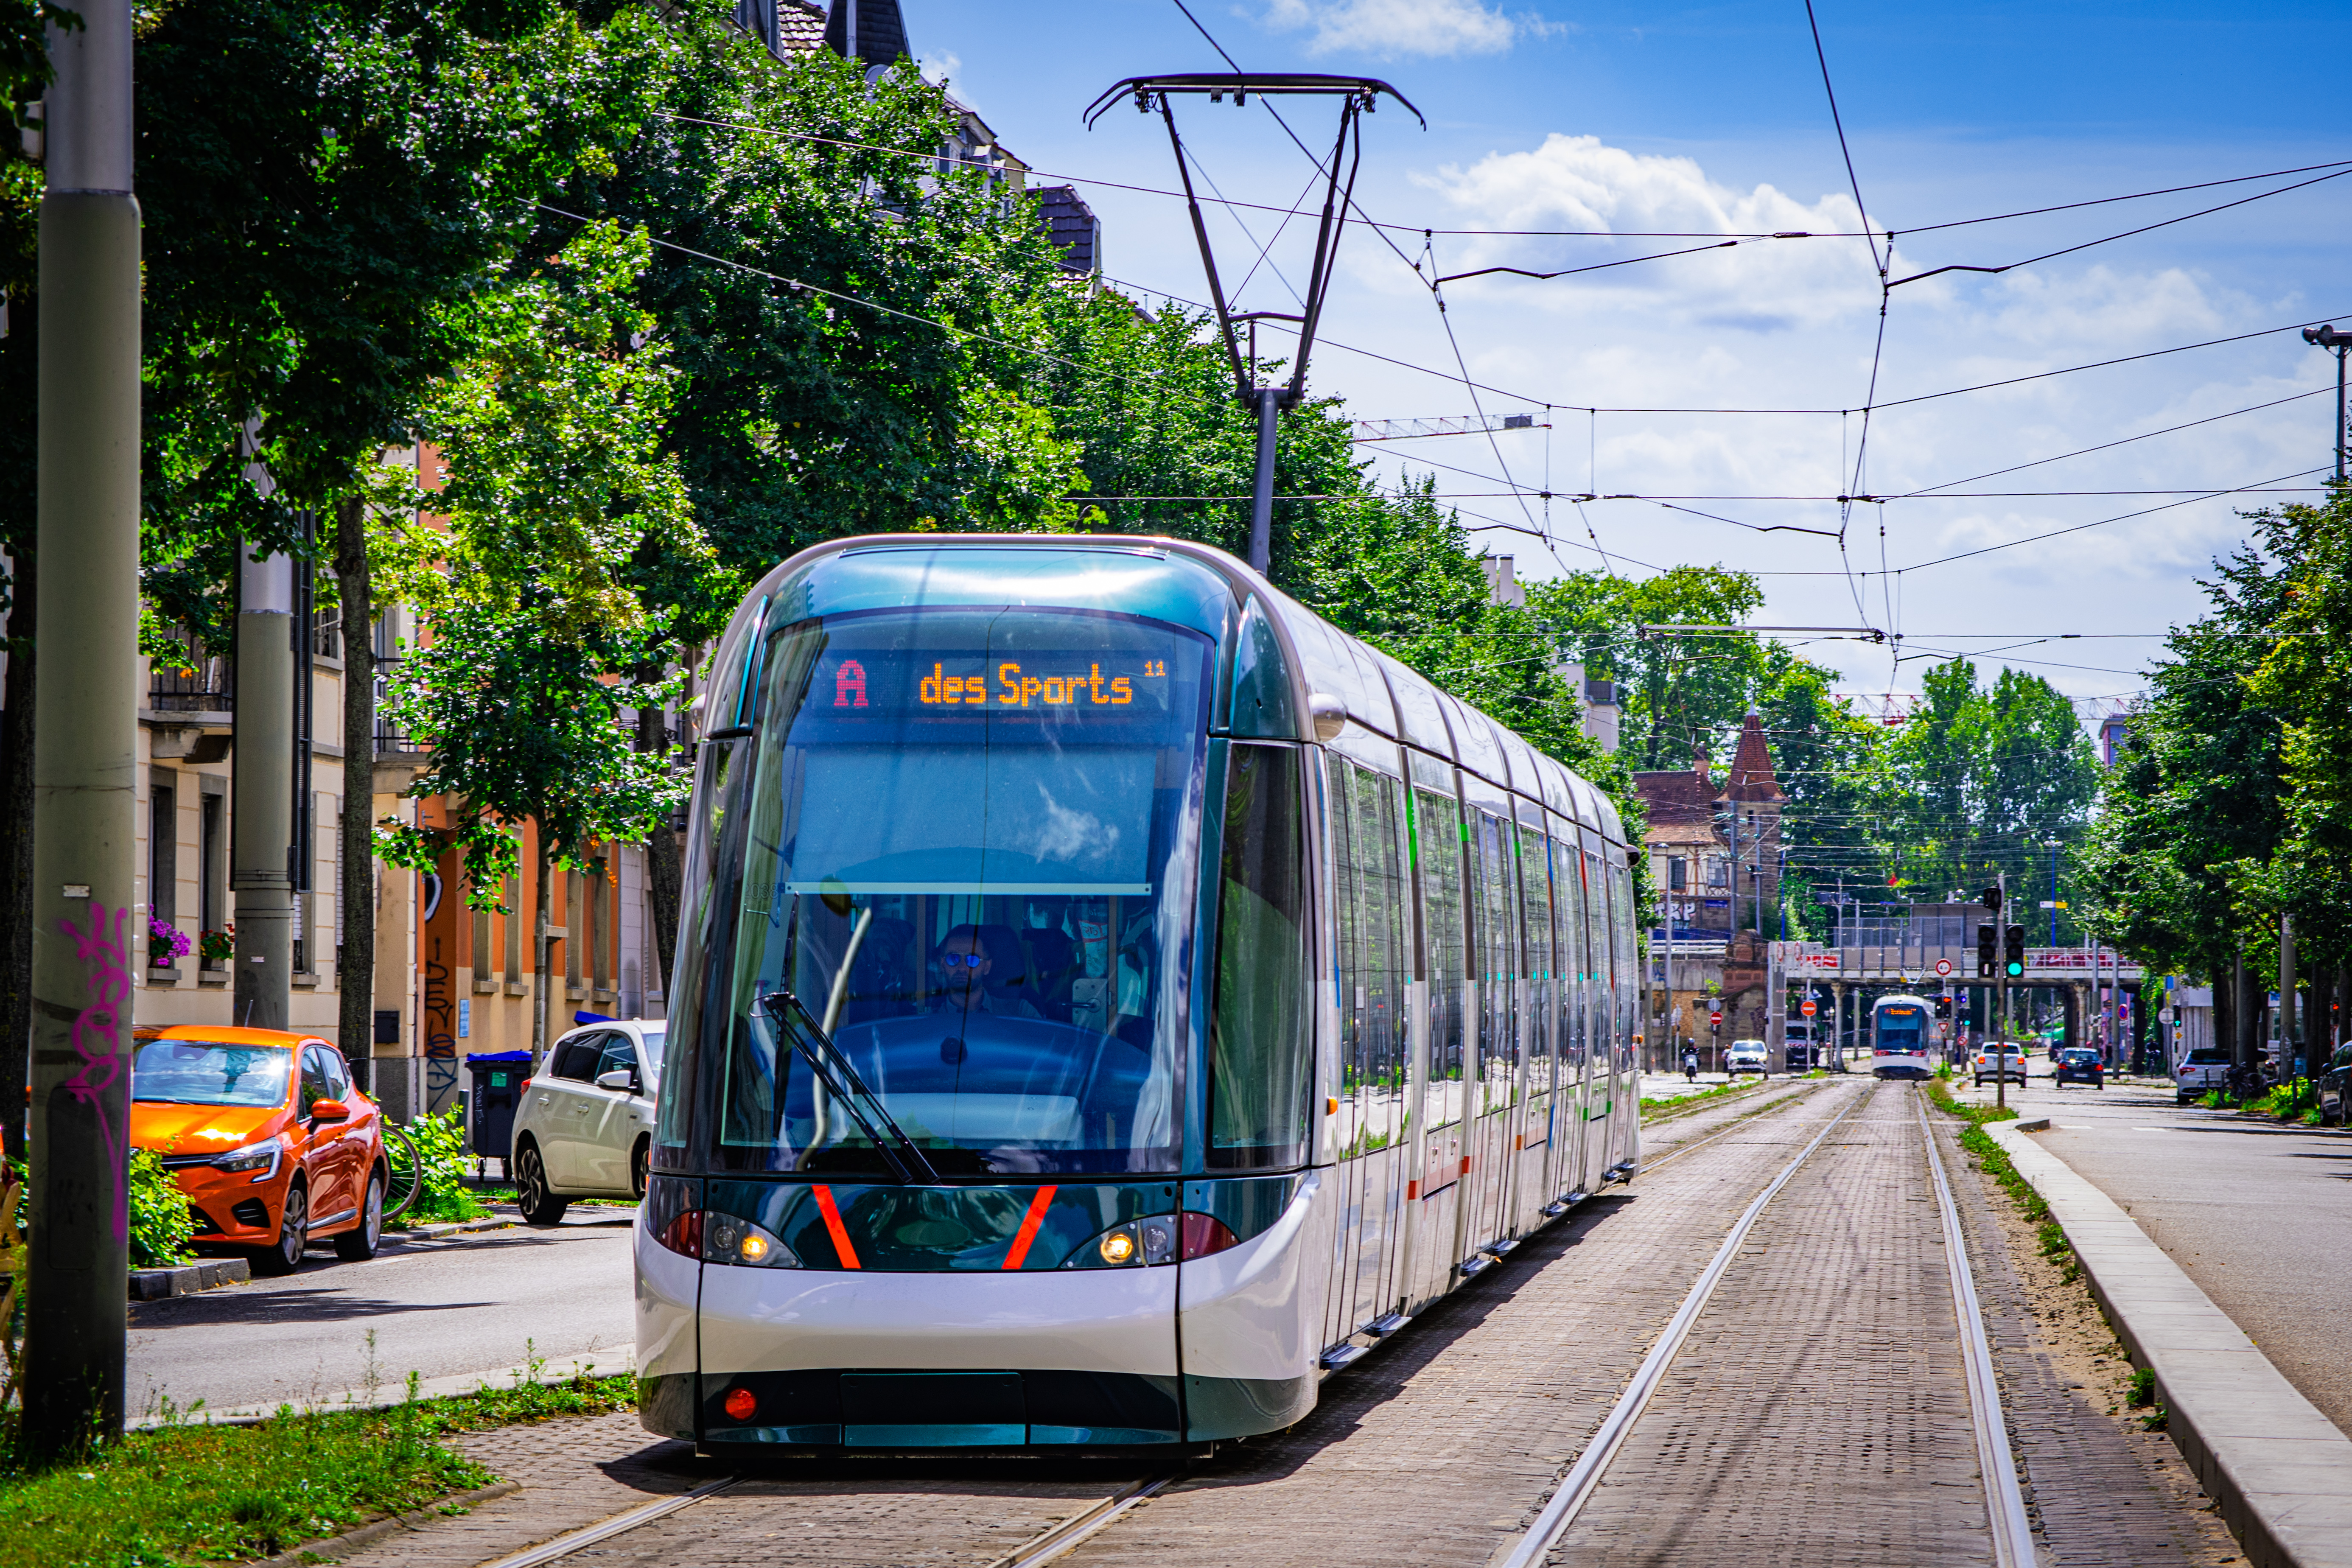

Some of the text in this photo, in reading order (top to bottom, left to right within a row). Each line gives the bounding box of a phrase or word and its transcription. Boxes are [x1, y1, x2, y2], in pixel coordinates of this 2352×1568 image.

[834, 661, 1166, 707] A des Sports 11
